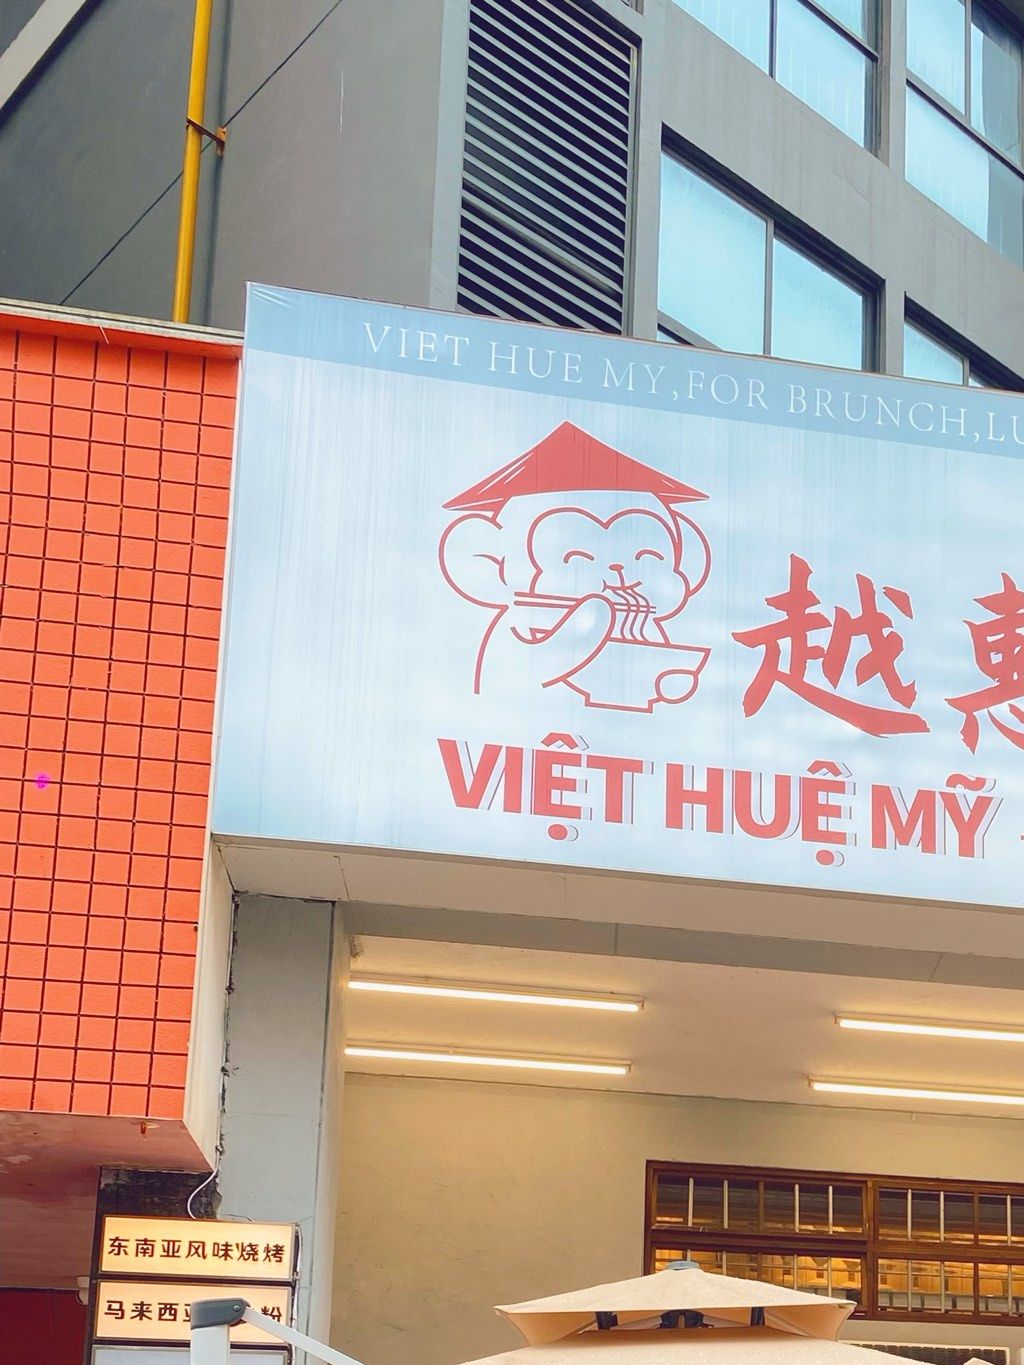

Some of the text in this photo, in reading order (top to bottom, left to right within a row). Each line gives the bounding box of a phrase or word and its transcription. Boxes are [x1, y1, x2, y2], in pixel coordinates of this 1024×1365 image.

[363, 322, 470, 367] VIET
[489, 341, 583, 384] HUE
[437, 731, 654, 843] VIỆT
[665, 758, 858, 868] HUỆ
[871, 772, 1004, 860] MỸ
[108, 1236, 286, 1264] 东南亚风味烧烤
[104, 1299, 283, 1324] 马来西粉
